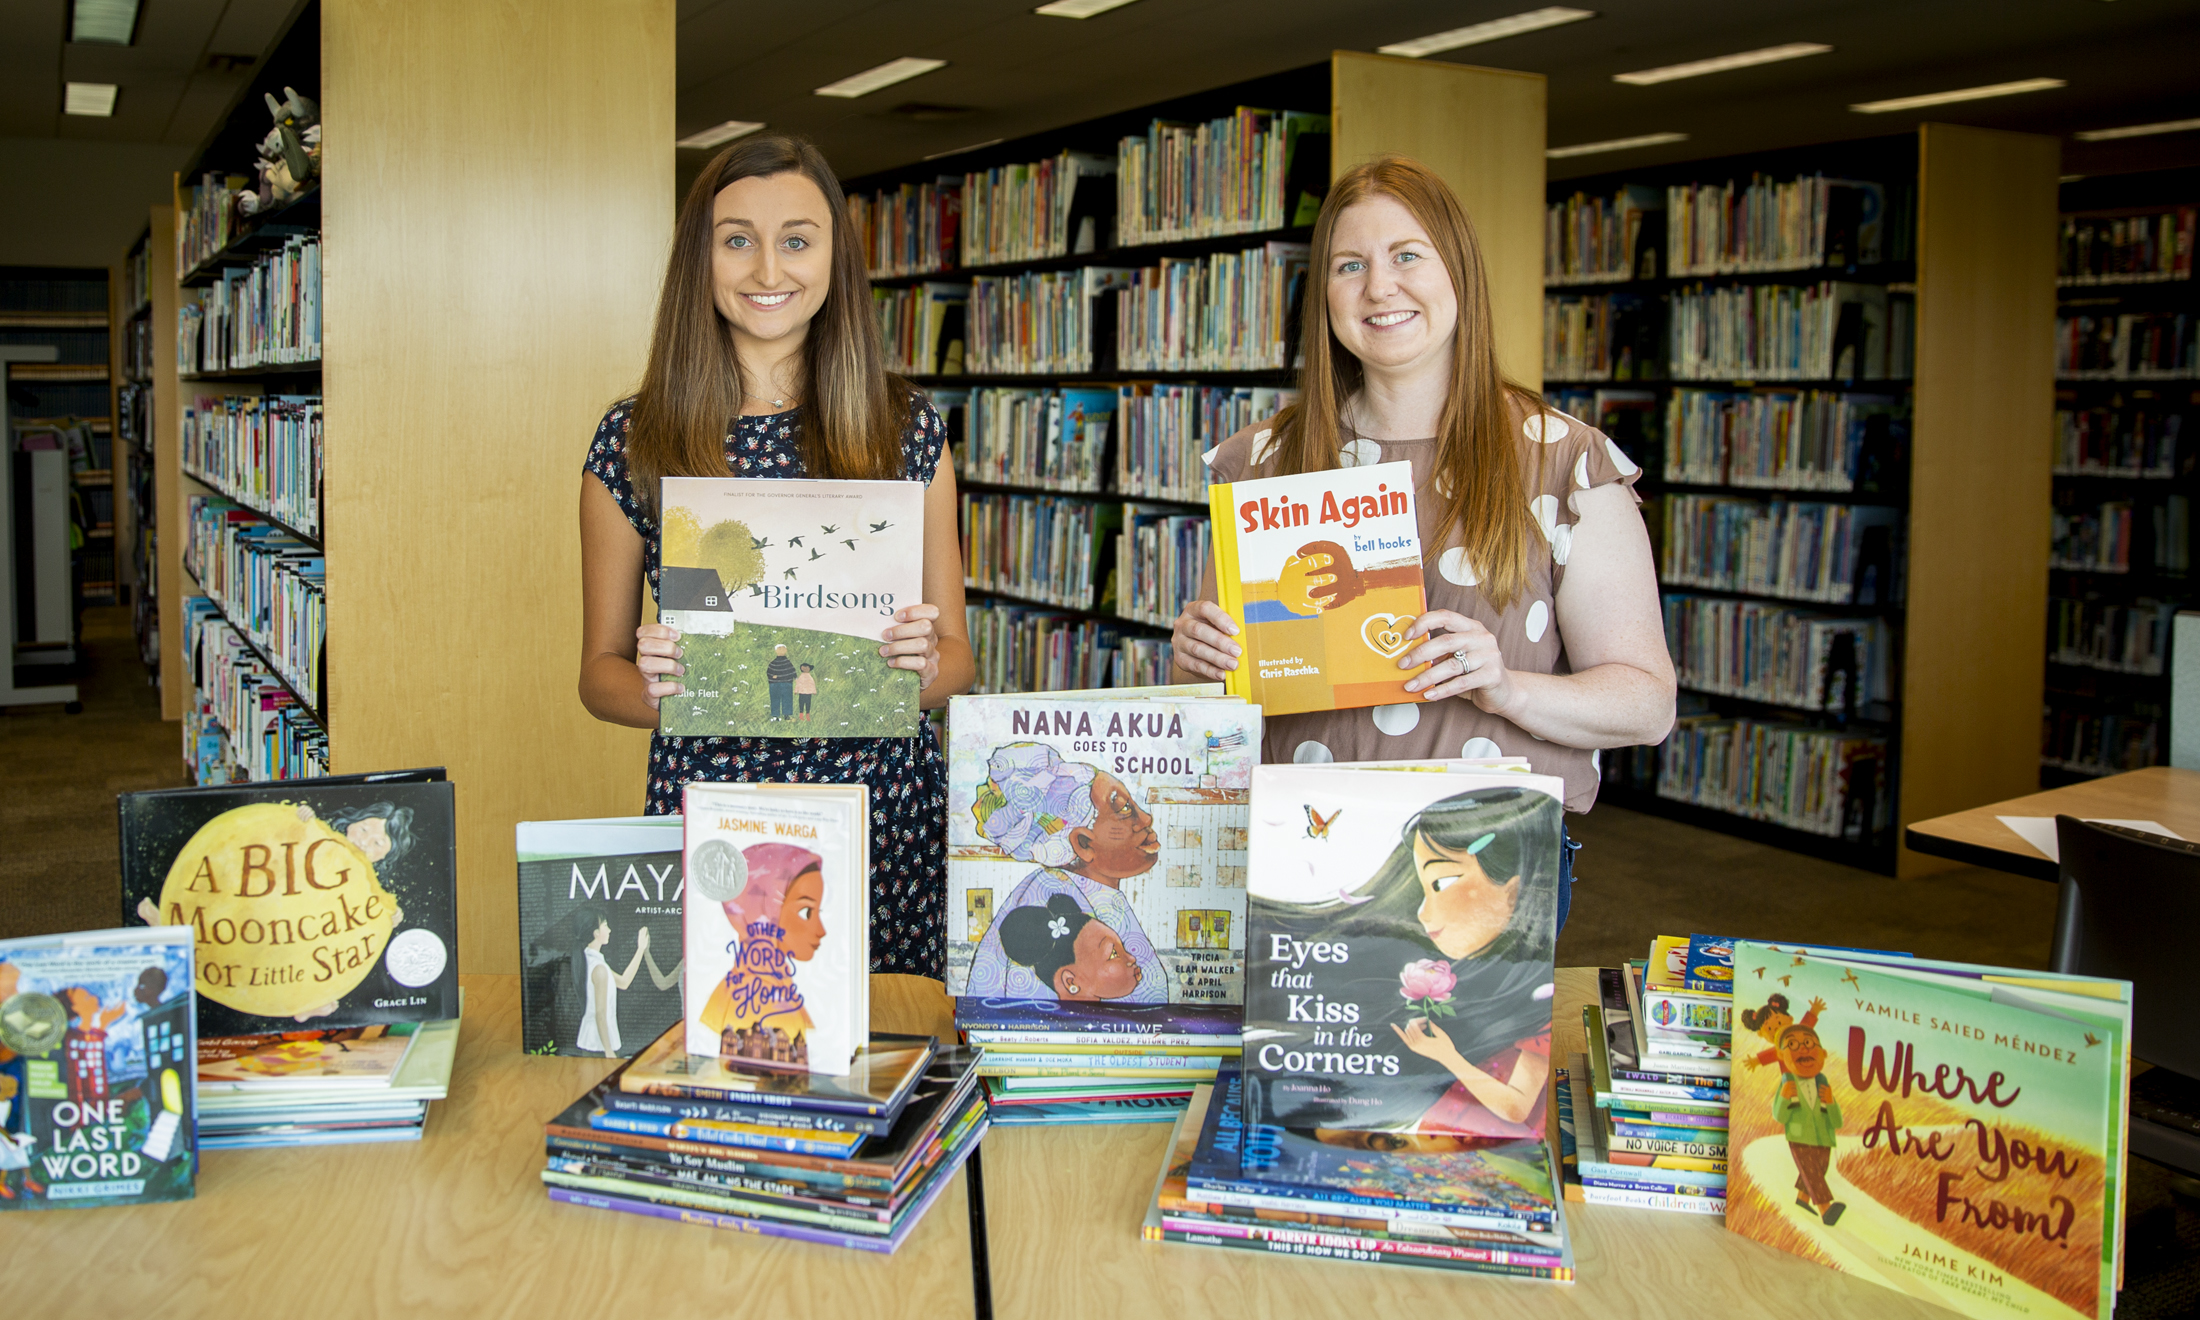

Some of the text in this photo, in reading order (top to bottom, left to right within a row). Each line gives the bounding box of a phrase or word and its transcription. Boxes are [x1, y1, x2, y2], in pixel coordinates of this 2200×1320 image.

[1240, 483, 1408, 533] Skin Again
[1354, 536, 1412, 552] bell hooks
[764, 584, 895, 616] Birdsong
[1258, 657, 1304, 667] Illustrated by
[1260, 666, 1319, 679] Chris Raschka
[698, 689, 719, 698] Flett
[1012, 710, 1183, 739] NANA AKUA
[1073, 741, 1127, 753] GOES TO
[1114, 756, 1194, 775] SCHOOL
[717, 817, 818, 839] JASMINE WARGA
[185, 838, 351, 898] A BIG
[170, 894, 384, 945] Mooncake
[747, 922, 786, 942] OTHER
[250, 964, 304, 986] Little
[312, 934, 375, 983] Star
[726, 939, 796, 977] WORDS
[1191, 953, 1220, 963] TRICIA
[1269, 934, 1349, 969] Eyes
[726, 971, 744, 988] for
[1175, 965, 1235, 975] ELAM WALKER
[1271, 968, 1314, 989] that
[1187, 977, 1222, 986] & APRIL
[374, 997, 427, 1008] GRACE LIN
[733, 977, 804, 1018] Home
[1182, 990, 1226, 999] HARRISON
[1287, 994, 1360, 1024] Kiss
[1101, 1023, 1163, 1034] SULWE
[1314, 1026, 1373, 1047] in the
[1854, 998, 2076, 1064] YAMILE SAIED MÉNDEZ
[1089, 1055, 1189, 1067] THE OLDEST STUDENT
[1259, 1044, 1400, 1076] Corners
[1847, 1026, 2020, 1108] Where
[1291, 1084, 1331, 1093] Joanna Ho
[1626, 1072, 1714, 1087] EWALD The
[52, 1100, 124, 1126] ONE
[1644, 1102, 1680, 1112] Hembrook
[1689, 1105, 1715, 1115] Butcher
[53, 1126, 126, 1153] LAST
[1213, 1130, 1242, 1154] ALL
[1626, 1140, 1642, 1150] NO
[1684, 1144, 1704, 1155] TOO
[1863, 1100, 2078, 1182] Are You
[42, 1152, 141, 1180] WORD
[668, 1152, 745, 1173] Yo Soy Muslim
[1591, 1166, 1642, 1177] Gaia Cornwall
[54, 1185, 89, 1196] NIKKI
[743, 1178, 762, 1191] THE
[1608, 1181, 1626, 1189] Murray
[1331, 1194, 1372, 1205] BECAUSE
[1374, 1198, 1394, 1207] YOU
[1396, 1200, 1430, 1210] MATTER
[1648, 1196, 1696, 1209] Children
[1936, 1172, 2075, 1249] From?
[1396, 1222, 1440, 1235] Dreamers
[1186, 1232, 1222, 1245] Lamothe
[1268, 1242, 1292, 1253] THIS
[1294, 1244, 1304, 1253] IS
[1306, 1246, 1332, 1256] HOW
[1334, 1248, 1349, 1258] WE
[1352, 1250, 1368, 1260] DO
[1371, 1252, 1380, 1261] IT
[1360, 1239, 1376, 1251] UP
[1396, 1243, 1452, 1258] Extraordinary
[1452, 1249, 1488, 1260] Moment
[1902, 1243, 2003, 1287] JAIME KIM
[1878, 1256, 1926, 1276] ILLUSTRATOR
[1941, 1279, 1959, 1290] TAKE
[1991, 1296, 2004, 1304] MY
[2006, 1300, 2030, 1313] CHILD
[1895, 1256, 2011, 1300] NEW YORK TIMES BESTSELLING
